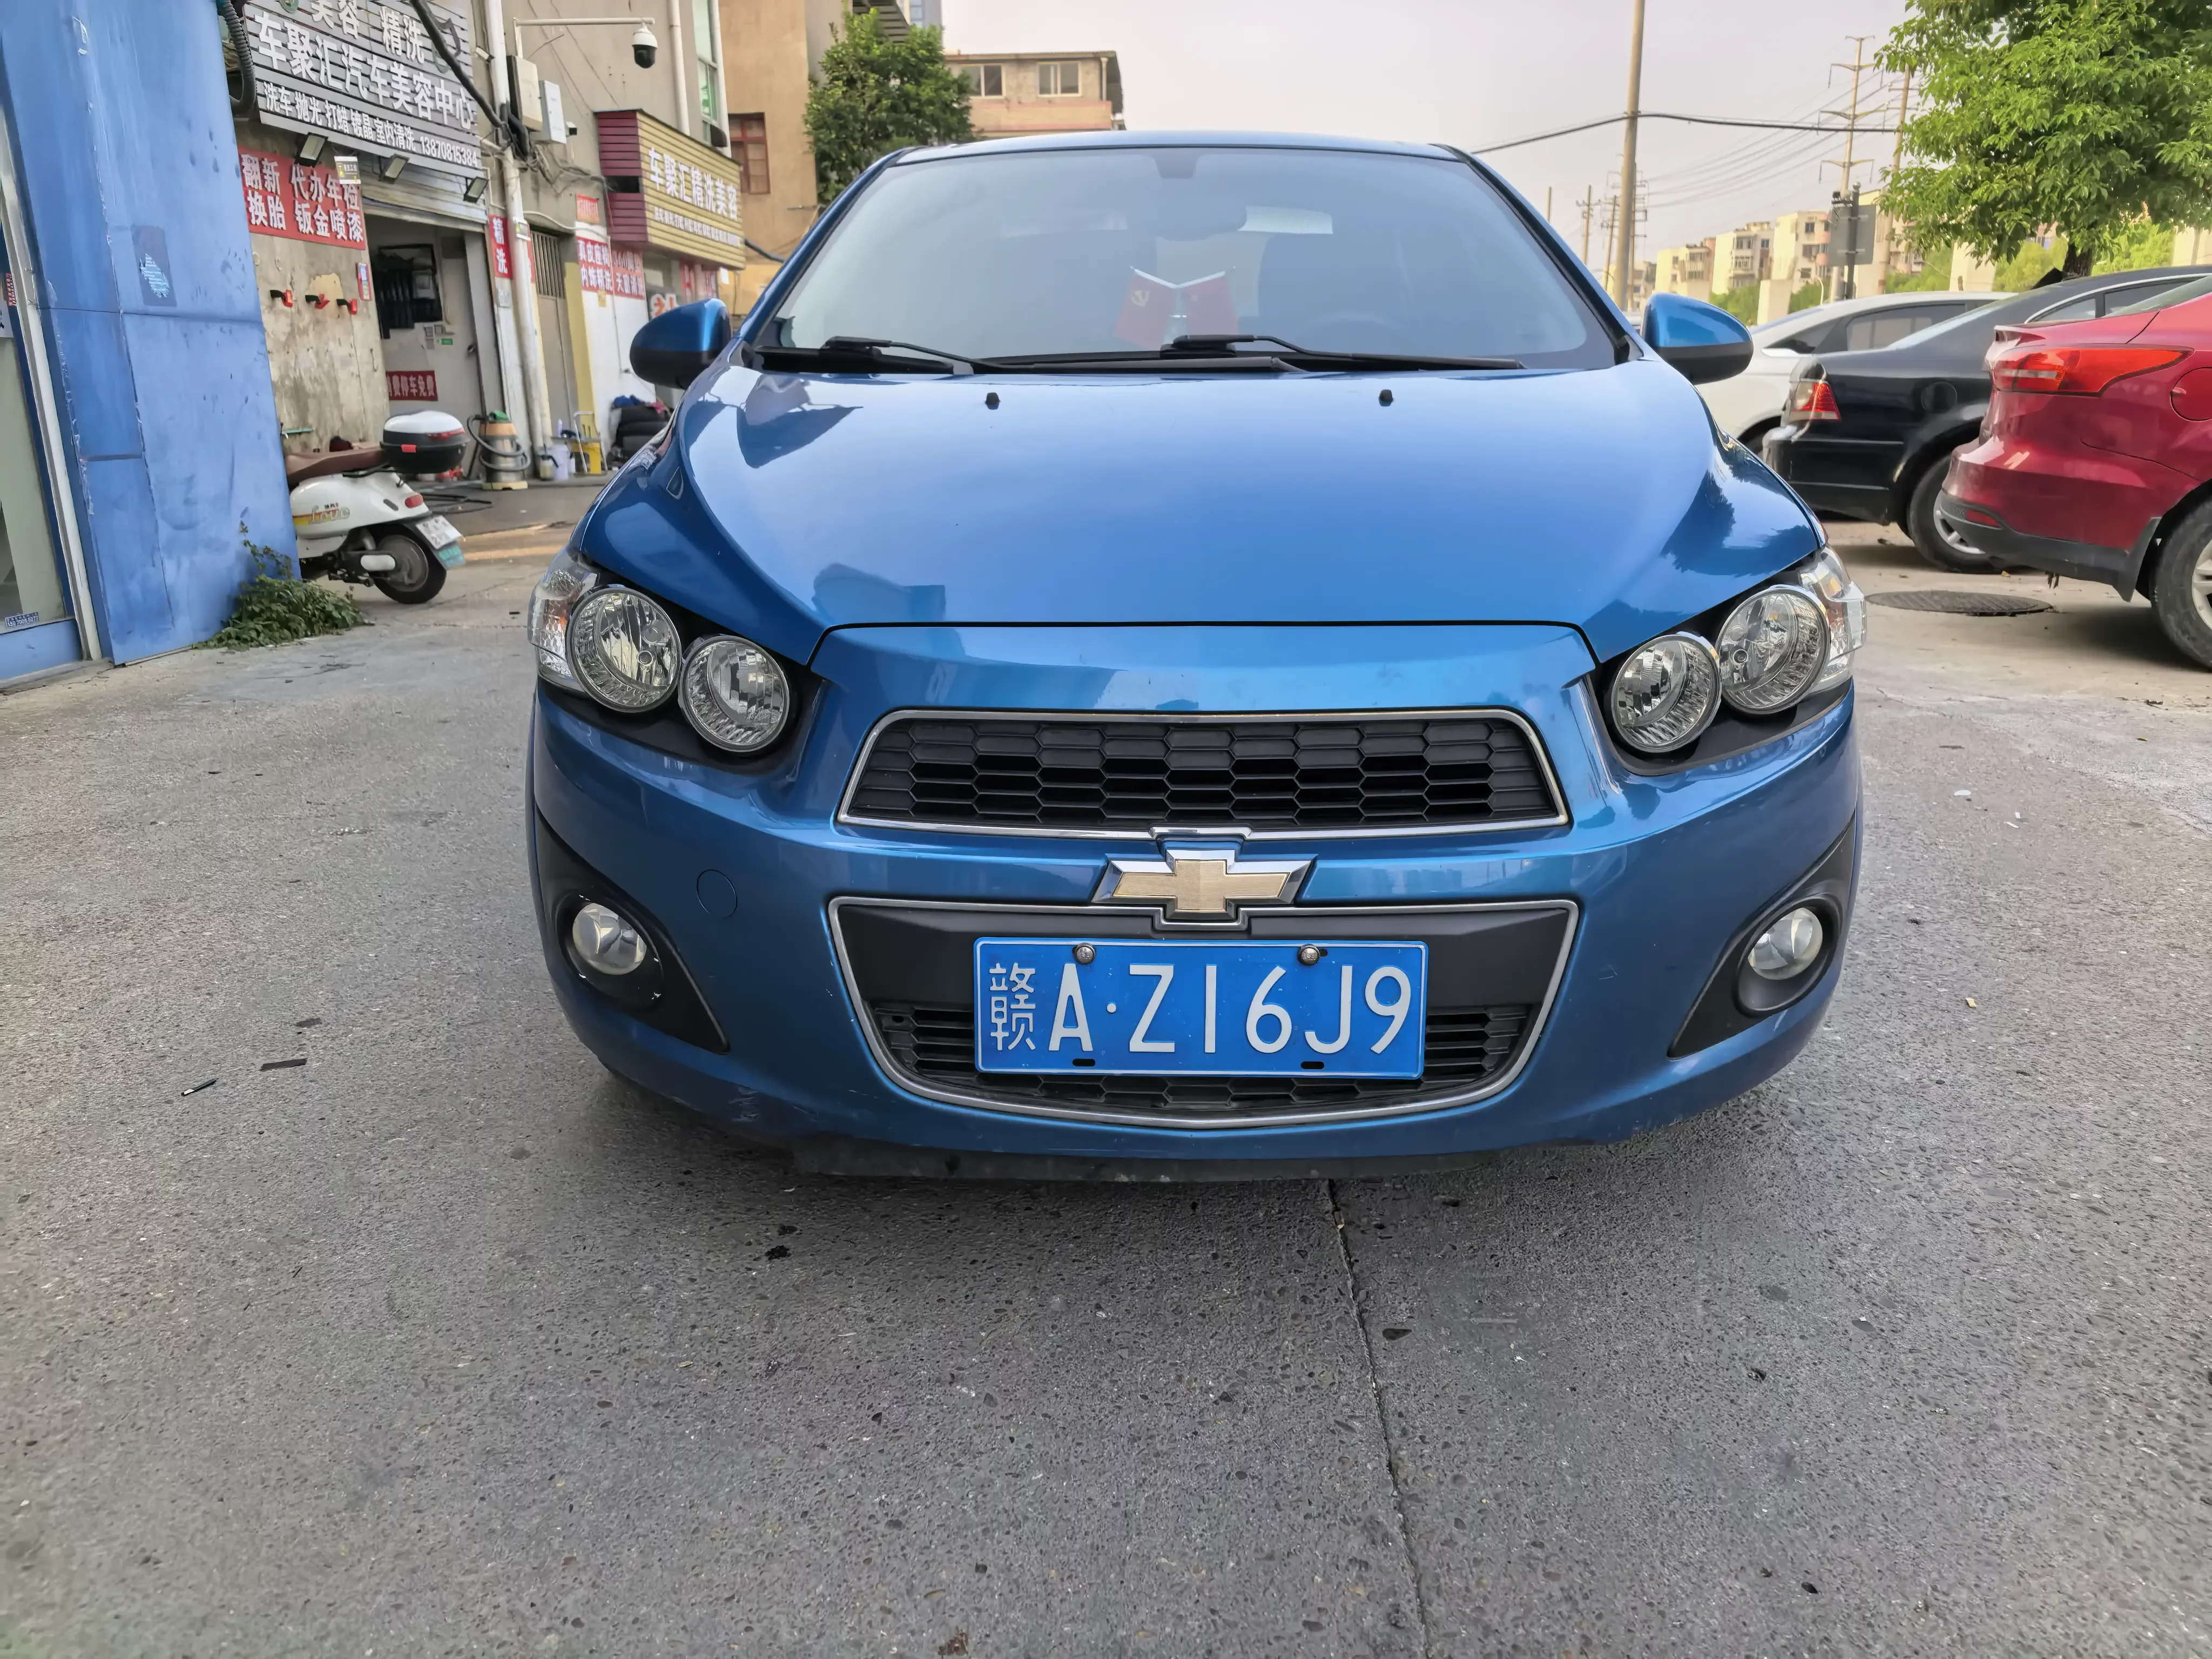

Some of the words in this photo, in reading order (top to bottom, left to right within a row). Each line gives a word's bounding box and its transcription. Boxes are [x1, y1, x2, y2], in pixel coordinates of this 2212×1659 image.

[256, 11, 474, 130] 车聚汇汽车美容中心
[380, 6, 424, 64] 精洗
[264, 82, 293, 116] 洗车
[295, 91, 322, 126] 抛光
[325, 99, 349, 133] 打蜡
[350, 109, 374, 141] 镀晶
[374, 118, 416, 152] 室内清洗
[420, 136, 478, 167] 13870815384
[241, 154, 280, 195] 翻新
[291, 163, 360, 211] 代办年检
[247, 190, 286, 230] 换胎
[294, 200, 363, 243] 钣金喷漆
[649, 146, 738, 221] 车聚汇精洗美容
[989, 962, 1411, 1054] 赣A·Z16J9
